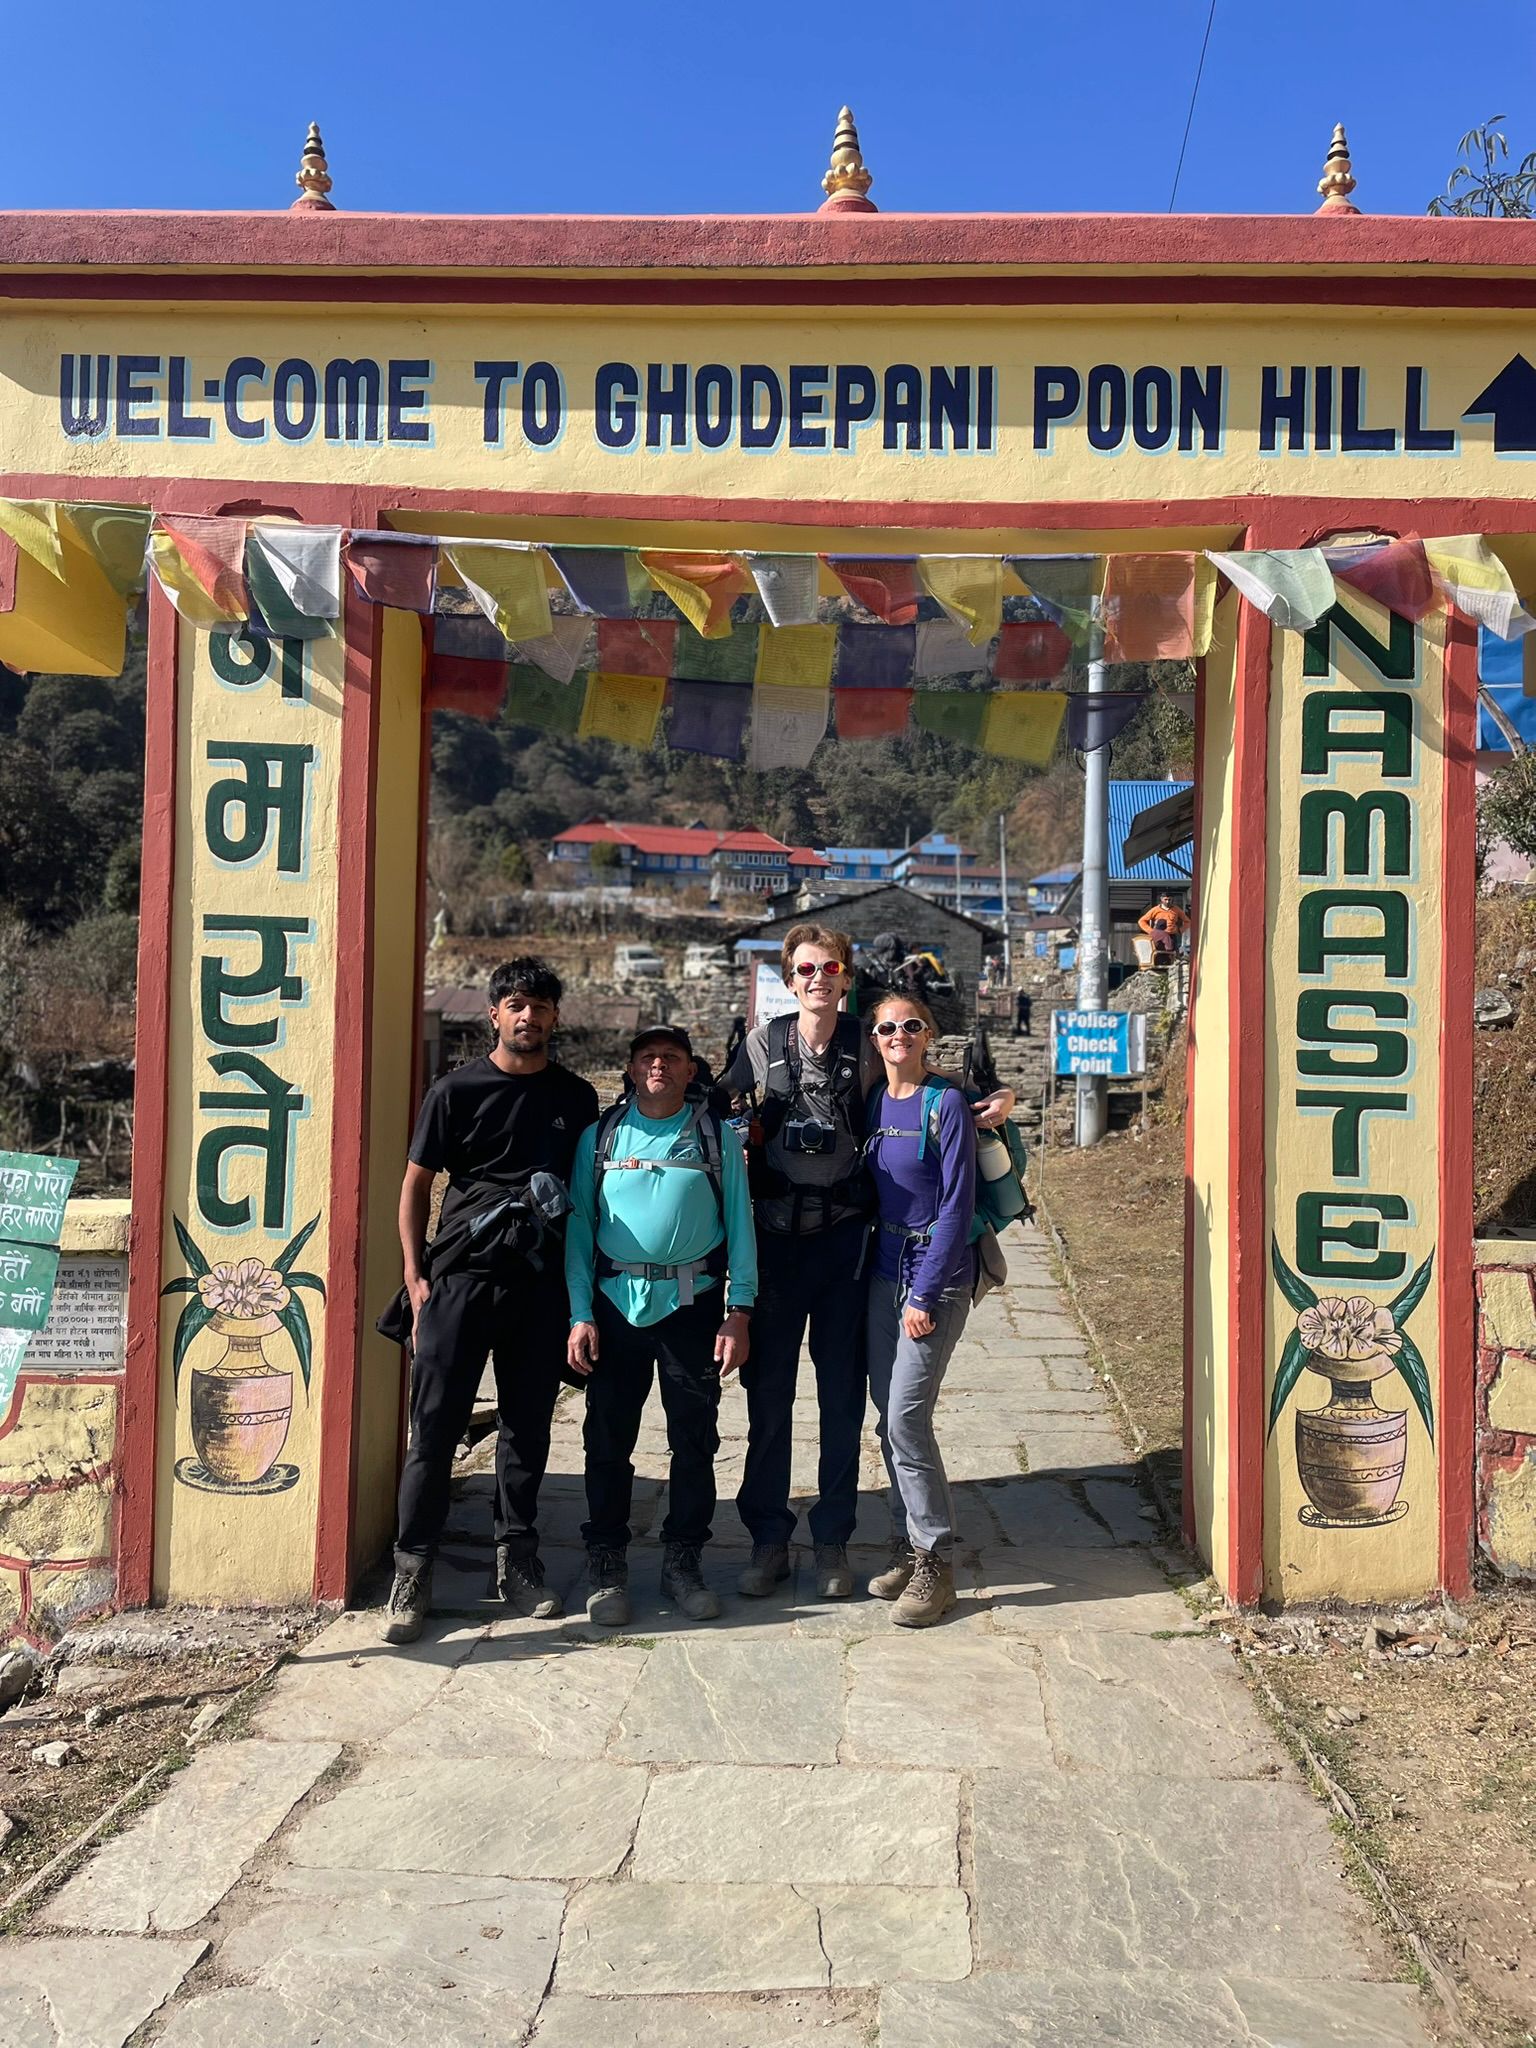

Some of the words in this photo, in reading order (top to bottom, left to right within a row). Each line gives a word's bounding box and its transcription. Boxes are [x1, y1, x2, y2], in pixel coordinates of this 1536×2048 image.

[60, 353, 432, 444] WEL-COME
[474, 360, 565, 450] TO
[595, 361, 996, 453] GHODEPANI
[1033, 364, 1228, 456] POON
[1260, 365, 1460, 457] HILL
[1296, 604, 1418, 1283] NAMASTE
[1067, 1012, 1119, 1029] Police
[1067, 1035, 1119, 1053] Check
[1070, 1056, 1113, 1073] Point
